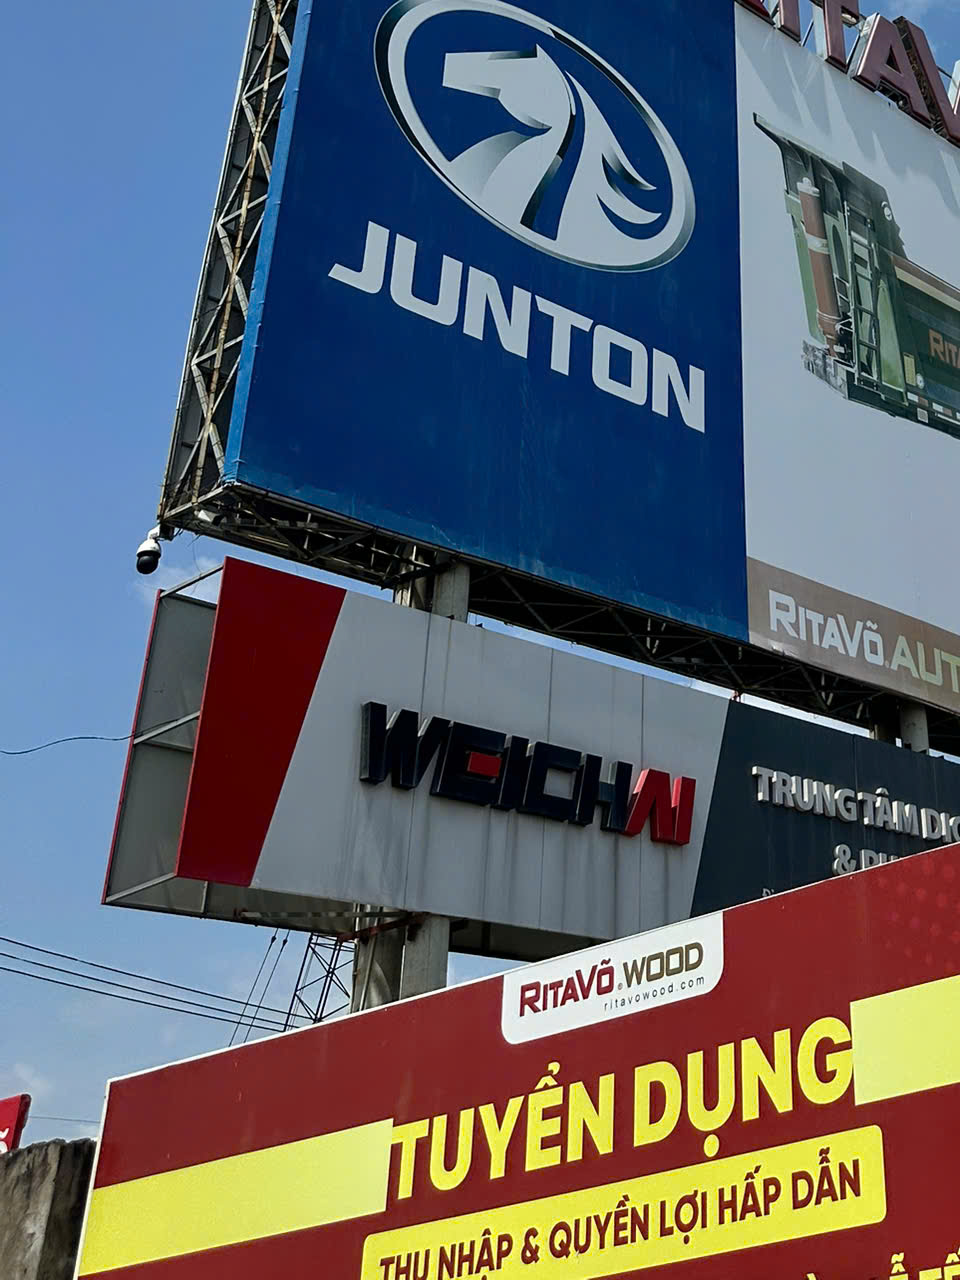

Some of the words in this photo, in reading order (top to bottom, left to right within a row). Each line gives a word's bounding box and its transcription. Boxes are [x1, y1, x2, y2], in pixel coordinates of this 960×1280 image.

[328, 220, 705, 432] JUNTON
[360, 701, 696, 846] WEICHAI
[752, 766, 857, 822] TRUNG
[858, 787, 920, 836] TÂM
[833, 844, 856, 875] &
[604, 975, 705, 1011] ritavowood.com
[393, 1062, 615, 1200] TUYỂN
[634, 1016, 853, 1157] DỤNG
[380, 1249, 431, 1280] THU
[439, 1229, 513, 1280] NHẬP
[521, 1228, 539, 1262] &
[548, 1194, 649, 1259] QUYỀN
[660, 1190, 708, 1245] LỢI
[719, 1164, 781, 1226] HẤP
[792, 1147, 861, 1210] DẪN
